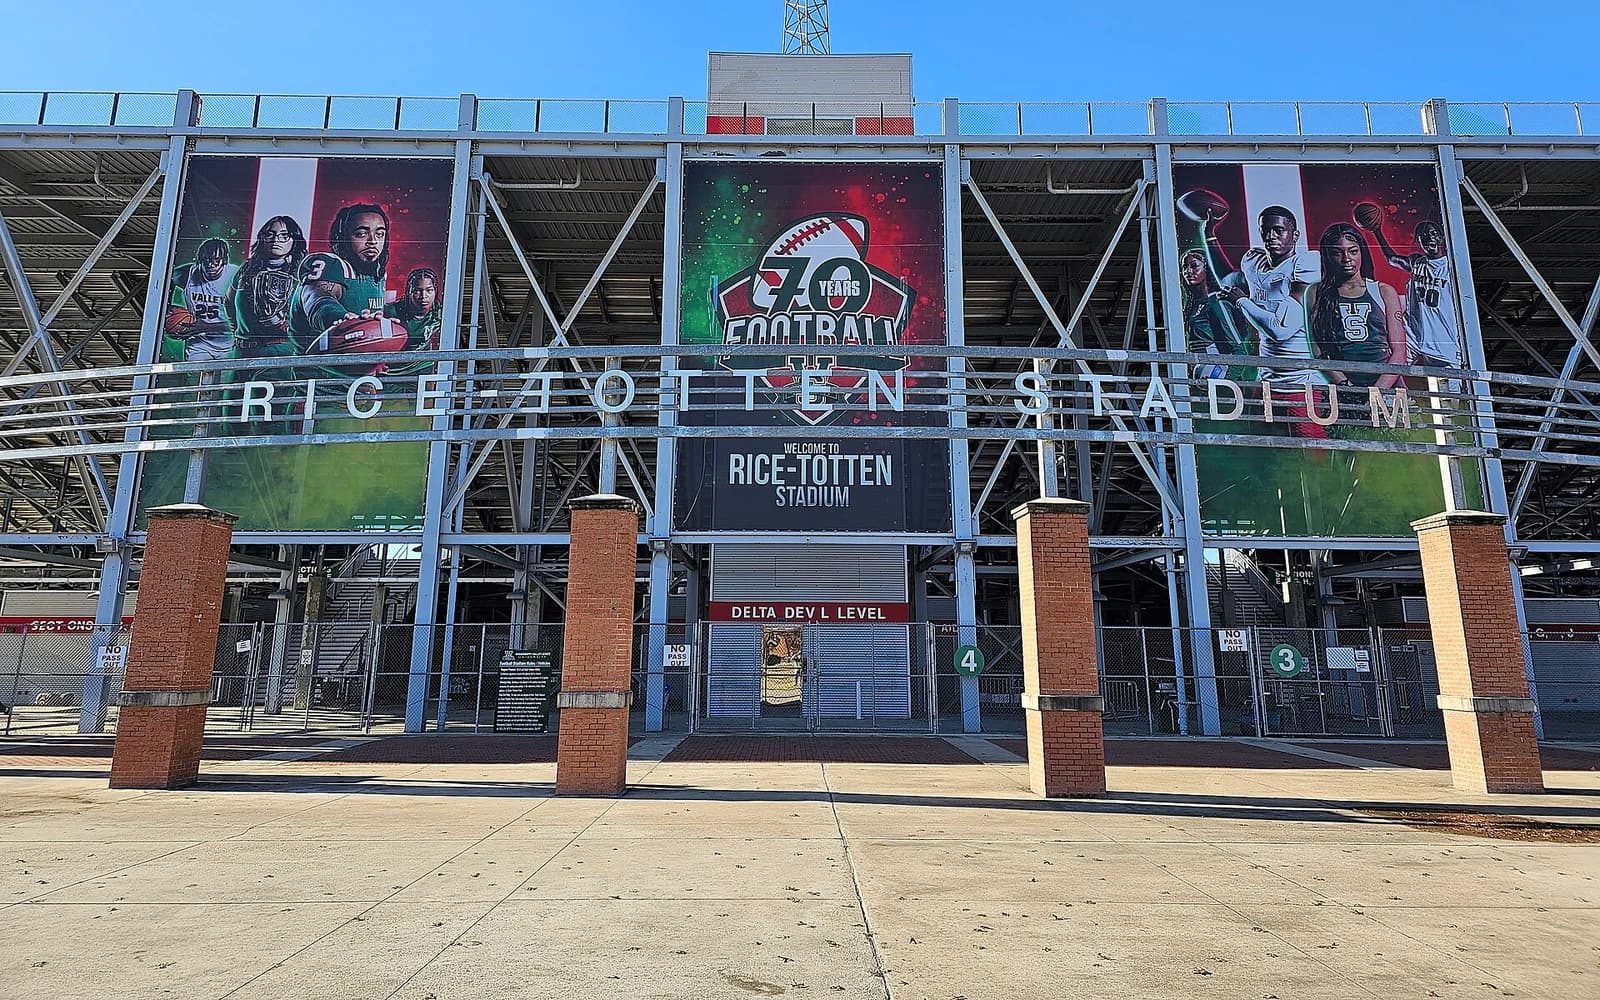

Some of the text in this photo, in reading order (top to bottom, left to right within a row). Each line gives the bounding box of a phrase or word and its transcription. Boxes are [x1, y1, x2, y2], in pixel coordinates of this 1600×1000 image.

[307, 260, 327, 280] 3
[760, 256, 872, 313] 70
[818, 280, 861, 297] YEARS
[195, 304, 220, 320] 25
[723, 313, 901, 353] FOOTBALL
[1013, 371, 1412, 429] STADIUM
[783, 442, 840, 455] WELCOME TO
[729, 453, 893, 486] RICE-TOTTEN
[775, 486, 850, 508] STADIUM
[731, 606, 777, 619] DELTA
[837, 606, 886, 619] LEVEL
[1225, 630, 1241, 638] NO
[105, 646, 121, 654] NO
[670, 645, 686, 653] NO
[960, 649, 978, 672] 4
[1278, 648, 1296, 672] 3
